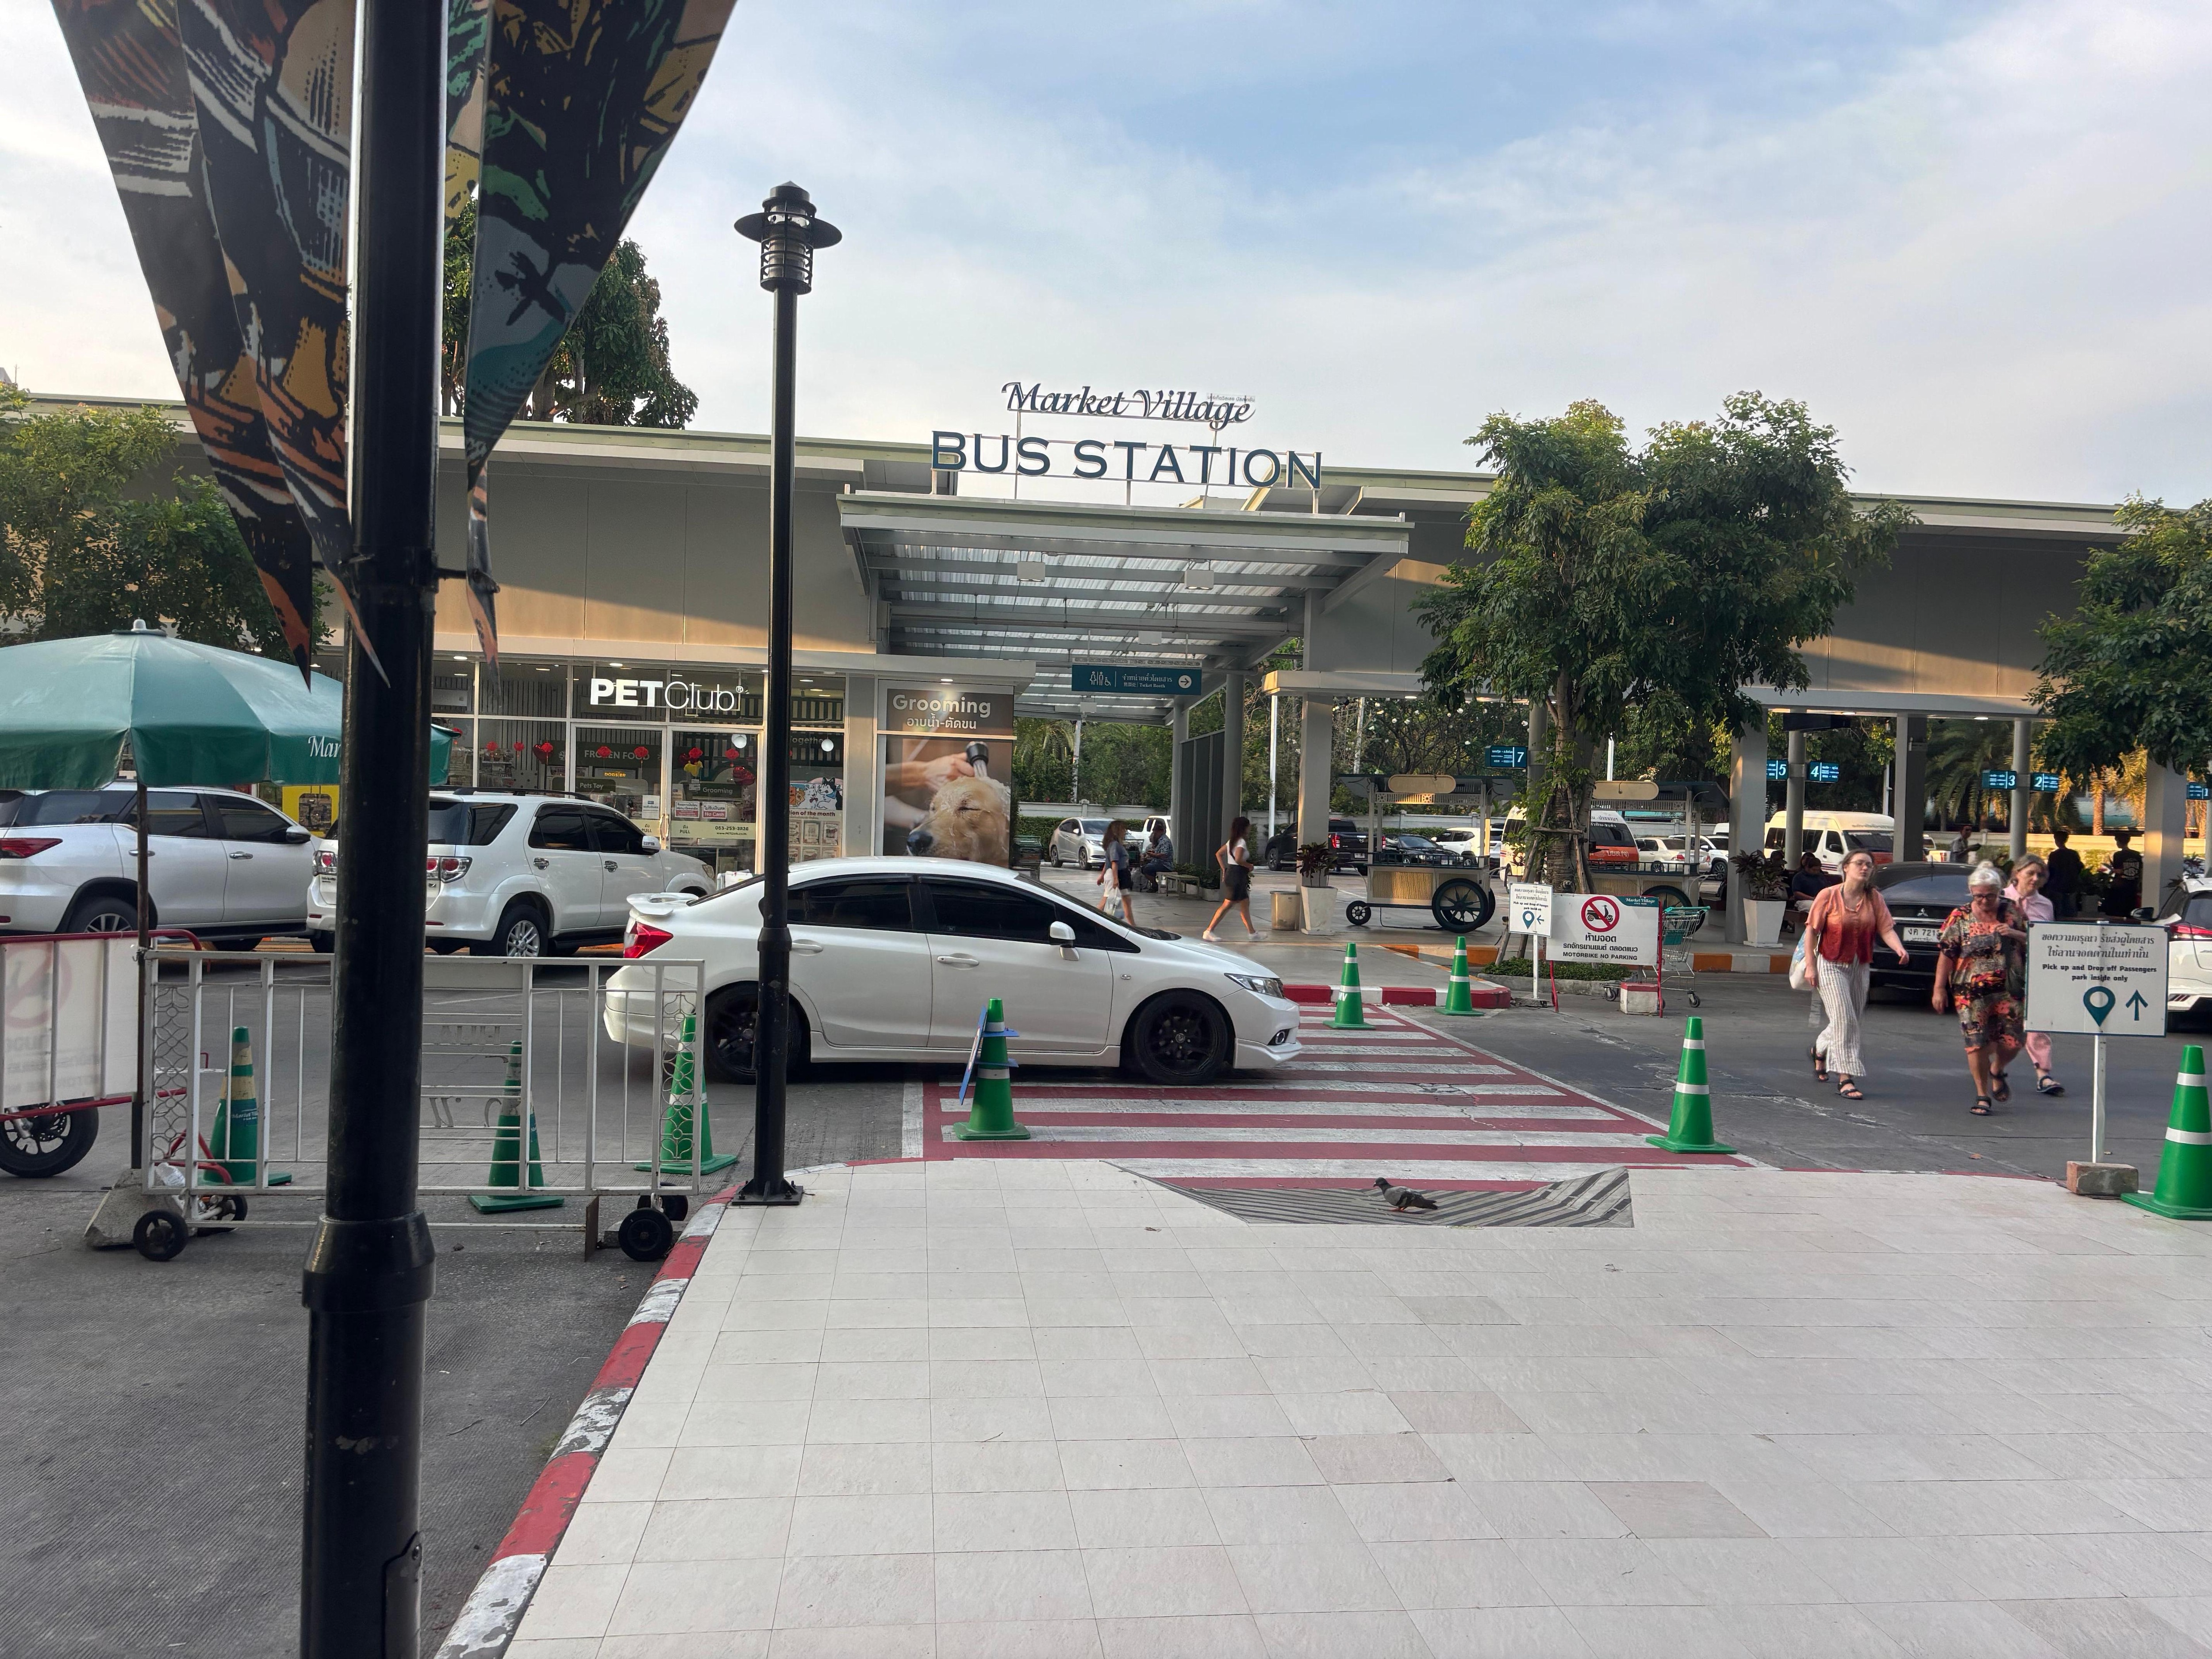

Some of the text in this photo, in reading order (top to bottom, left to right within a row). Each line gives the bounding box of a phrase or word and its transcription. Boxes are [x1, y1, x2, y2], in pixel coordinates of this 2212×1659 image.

[1002, 382, 1256, 430] Market Village
[932, 431, 1323, 489] BUS STATION
[893, 694, 991, 718] Grooming
[907, 713, 976, 730] อาบน้ำ-ตัดขน
[308, 736, 341, 757] Mar
[584, 750, 620, 759] FROEN
[1517, 752, 1524, 762] 7
[1778, 764, 1786, 776] 5
[1811, 766, 1819, 777] 4
[2008, 775, 2016, 786] 3
[2034, 776, 2042, 787] 2
[1585, 933, 1617, 942] ห้ามจอด
[2042, 933, 2097, 944] ขอความกรุณา
[1563, 942, 1607, 951] รถจักรยานยนต์
